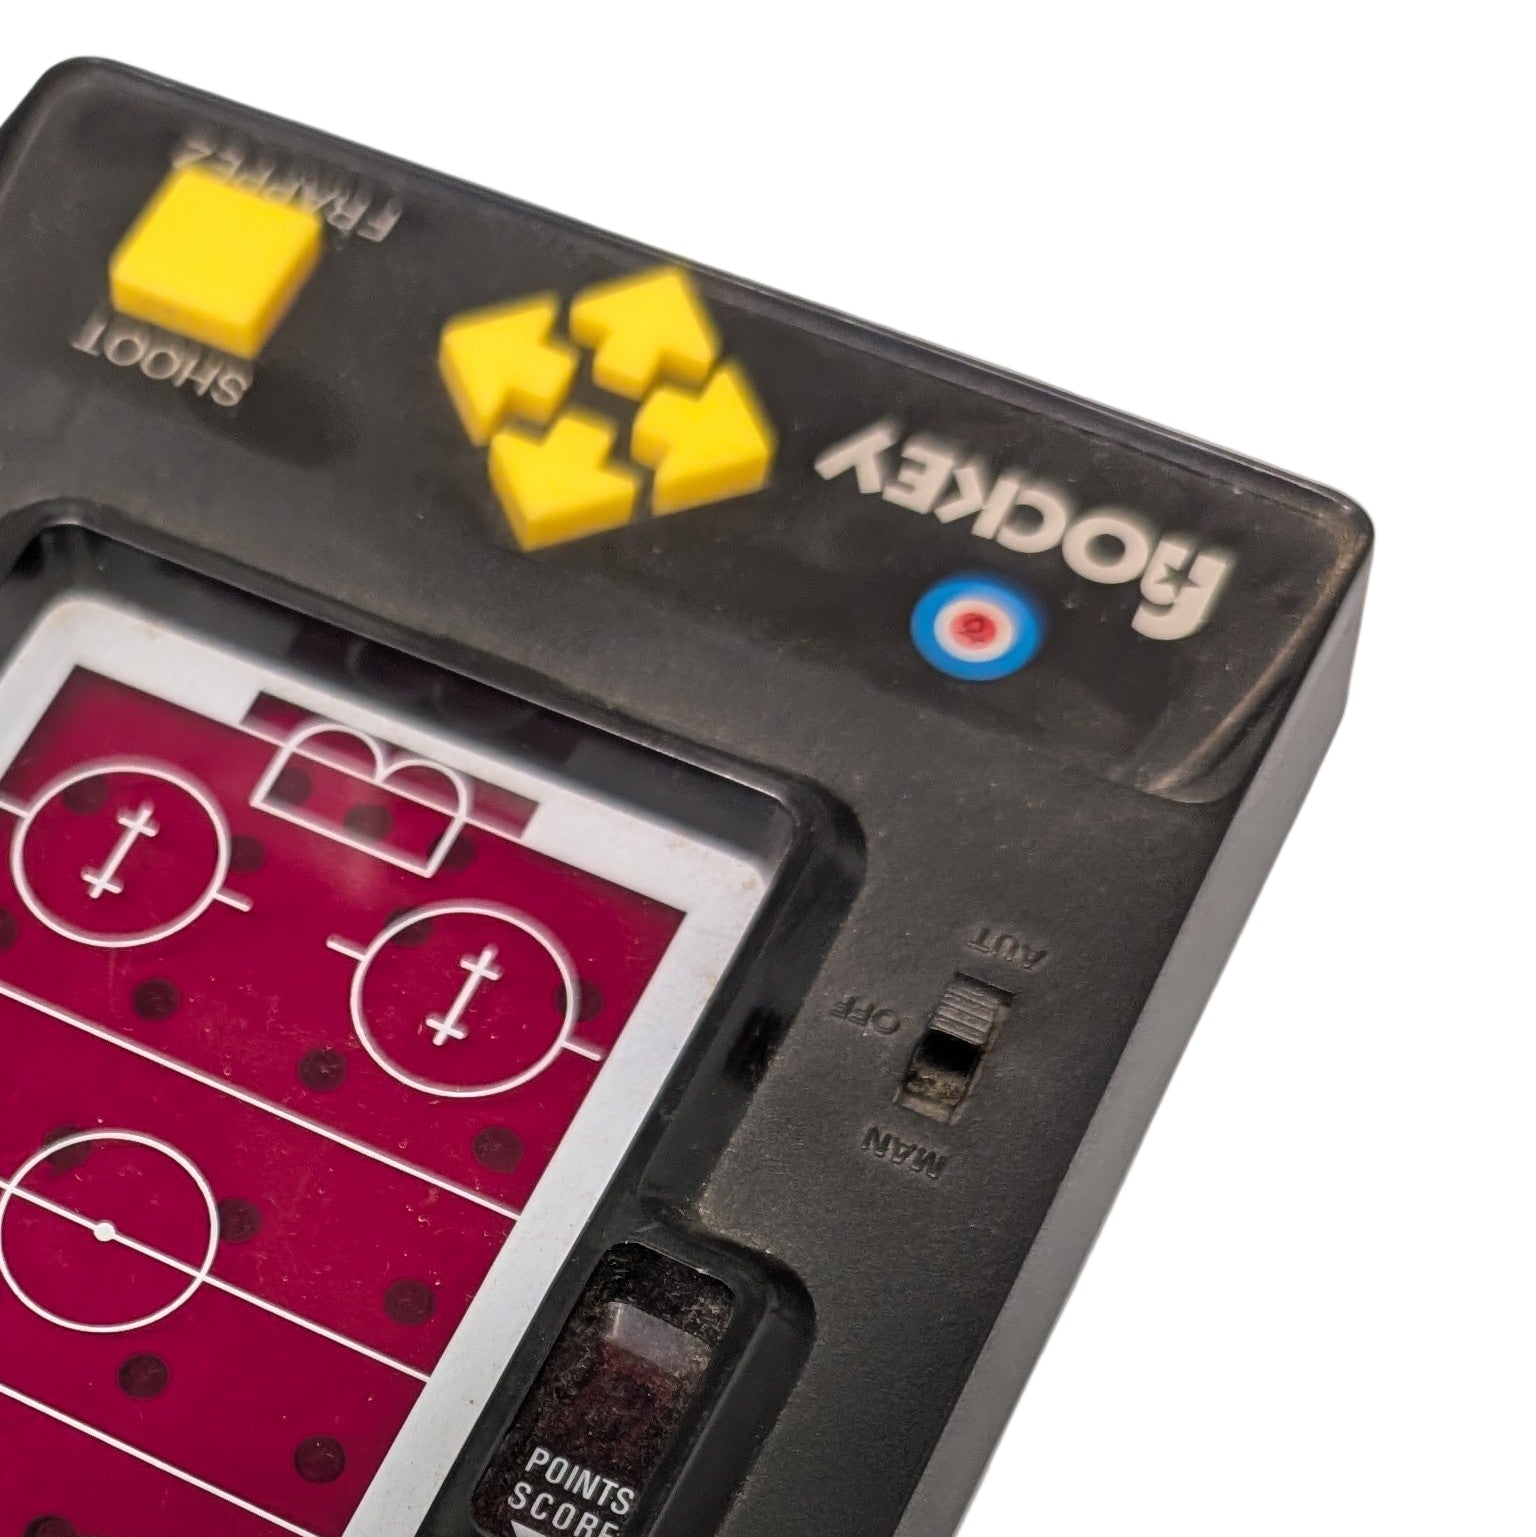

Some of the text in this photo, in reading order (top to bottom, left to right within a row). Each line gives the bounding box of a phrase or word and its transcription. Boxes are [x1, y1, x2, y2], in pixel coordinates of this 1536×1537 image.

[70, 303, 254, 407] SHOOT
[814, 417, 1232, 640] HOCKEY
[969, 926, 1048, 972] AUT
[830, 996, 901, 1035] OFF
[861, 1126, 949, 1180] MAN
[524, 1447, 635, 1515] POINTS
